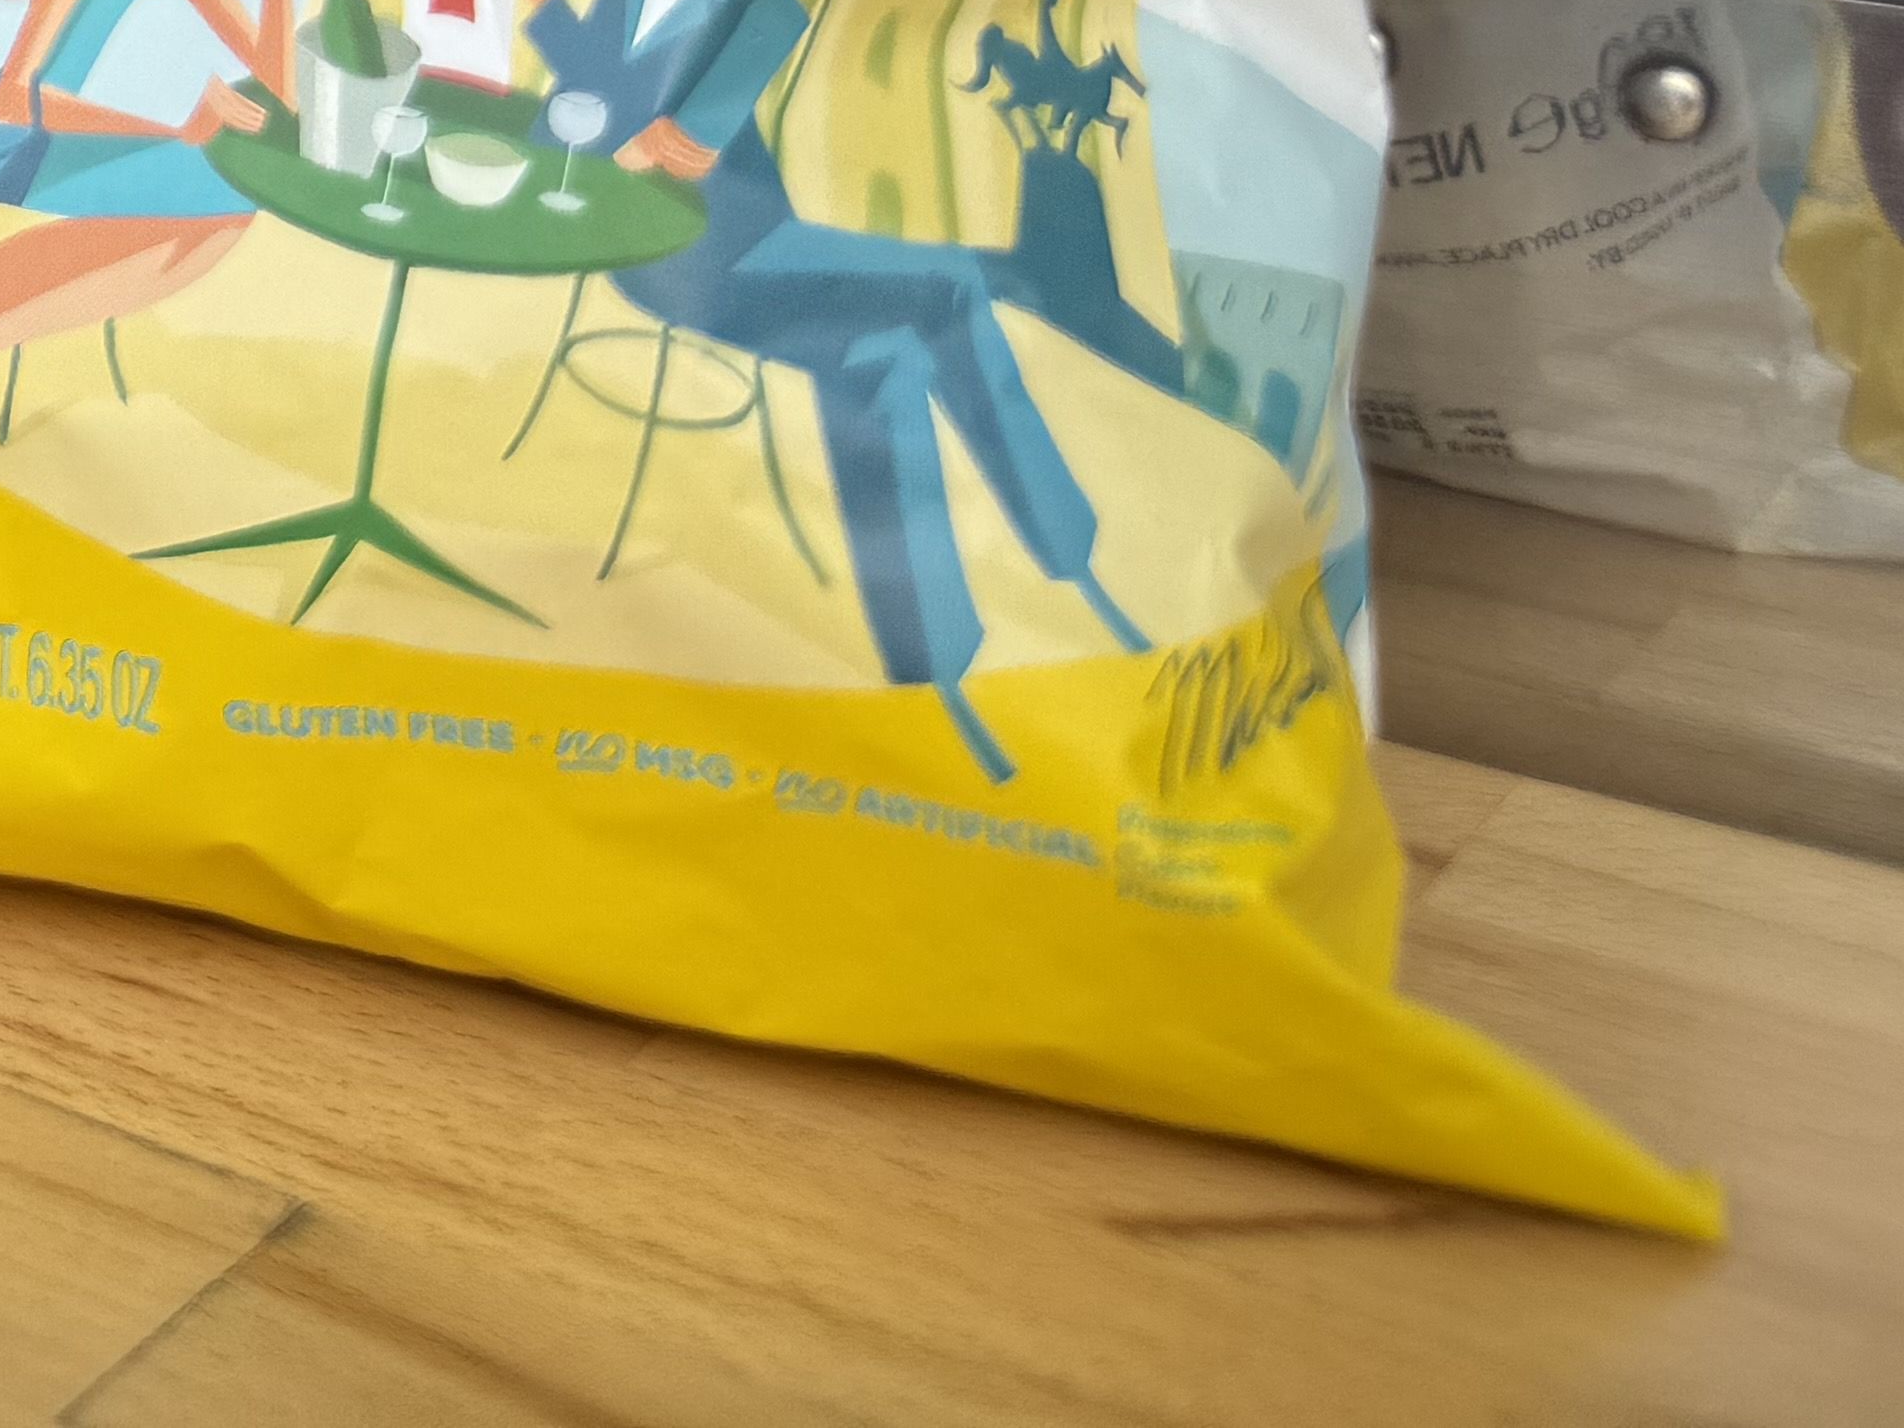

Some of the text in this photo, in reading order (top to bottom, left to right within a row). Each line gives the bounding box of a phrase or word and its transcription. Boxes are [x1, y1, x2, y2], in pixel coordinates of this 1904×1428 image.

[27, 629, 105, 720] 6.35
[111, 648, 162, 734] OZ
[222, 698, 398, 739] GLUTEN
[407, 710, 516, 753] FREE
[634, 739, 735, 791] MSG
